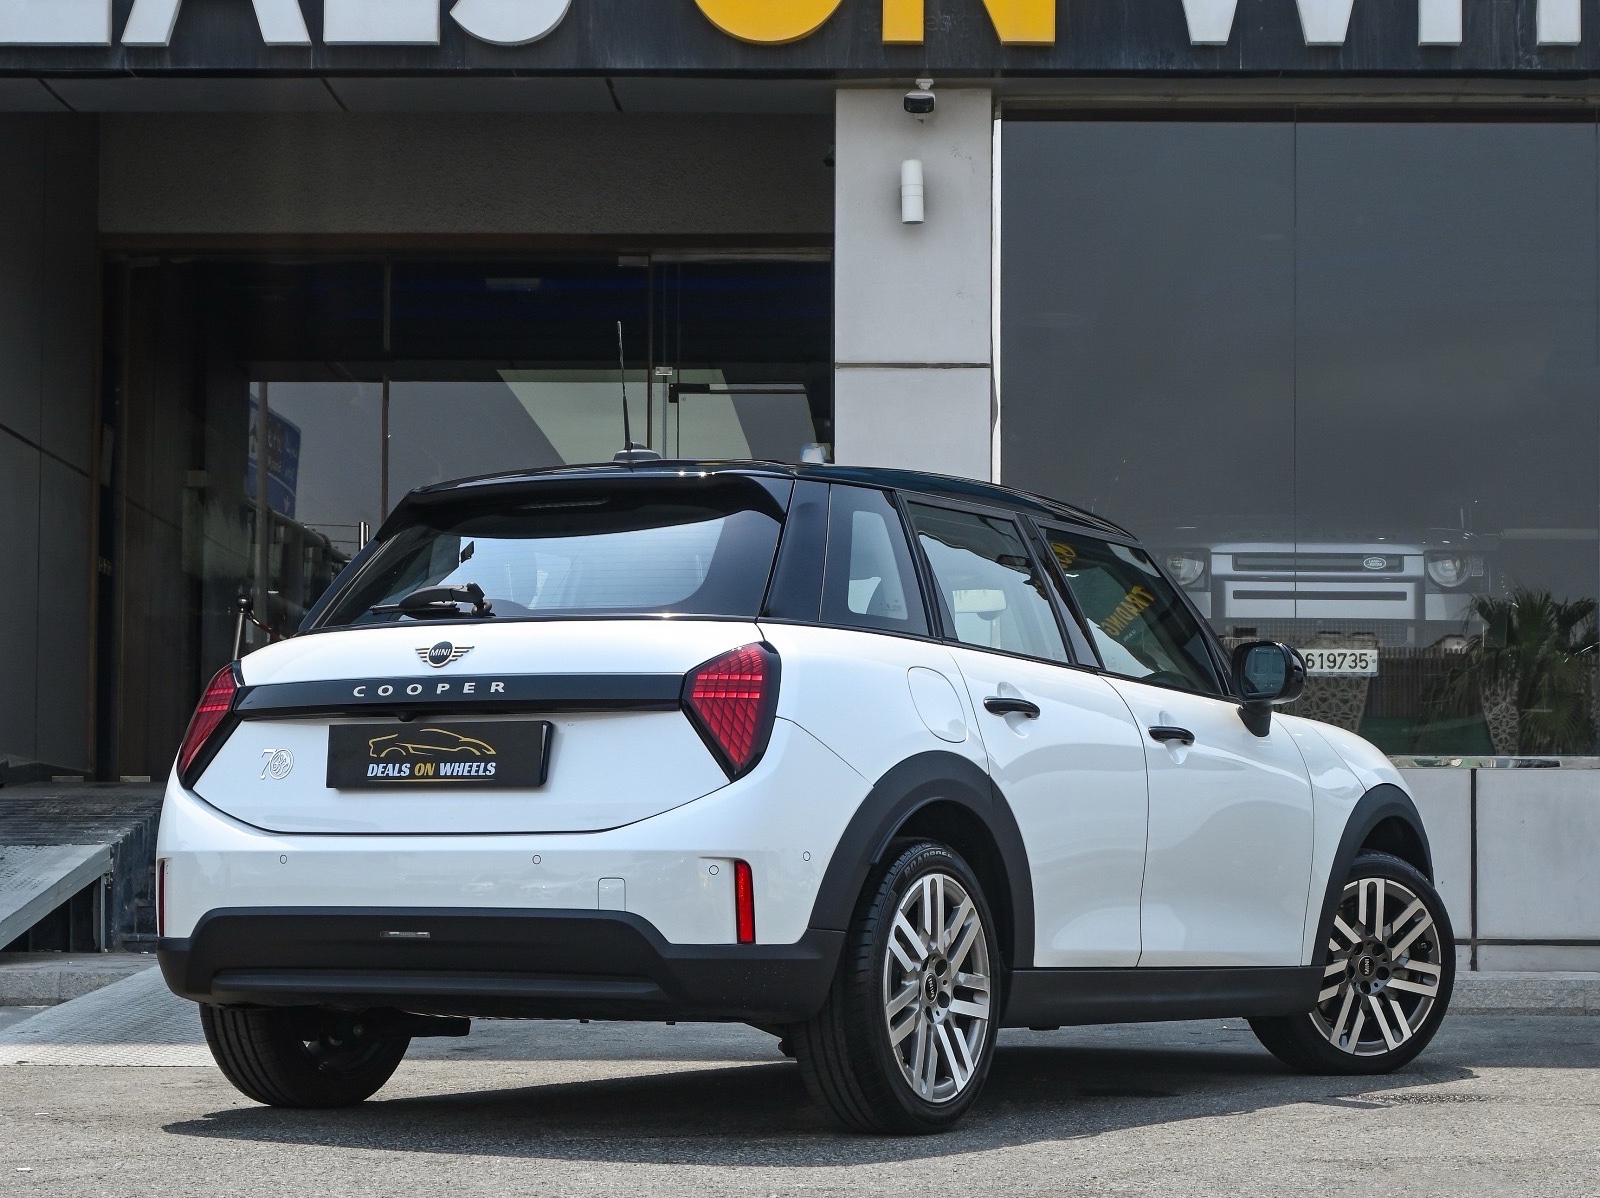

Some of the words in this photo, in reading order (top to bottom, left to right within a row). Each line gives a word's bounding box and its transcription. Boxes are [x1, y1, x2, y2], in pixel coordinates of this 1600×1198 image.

[430, 648, 451, 657] MINI
[1305, 652, 1369, 670] 619735
[353, 681, 505, 697] COOPER
[367, 763, 411, 777] DEALS
[414, 762, 435, 776] ON
[439, 762, 496, 776] WHEELS
